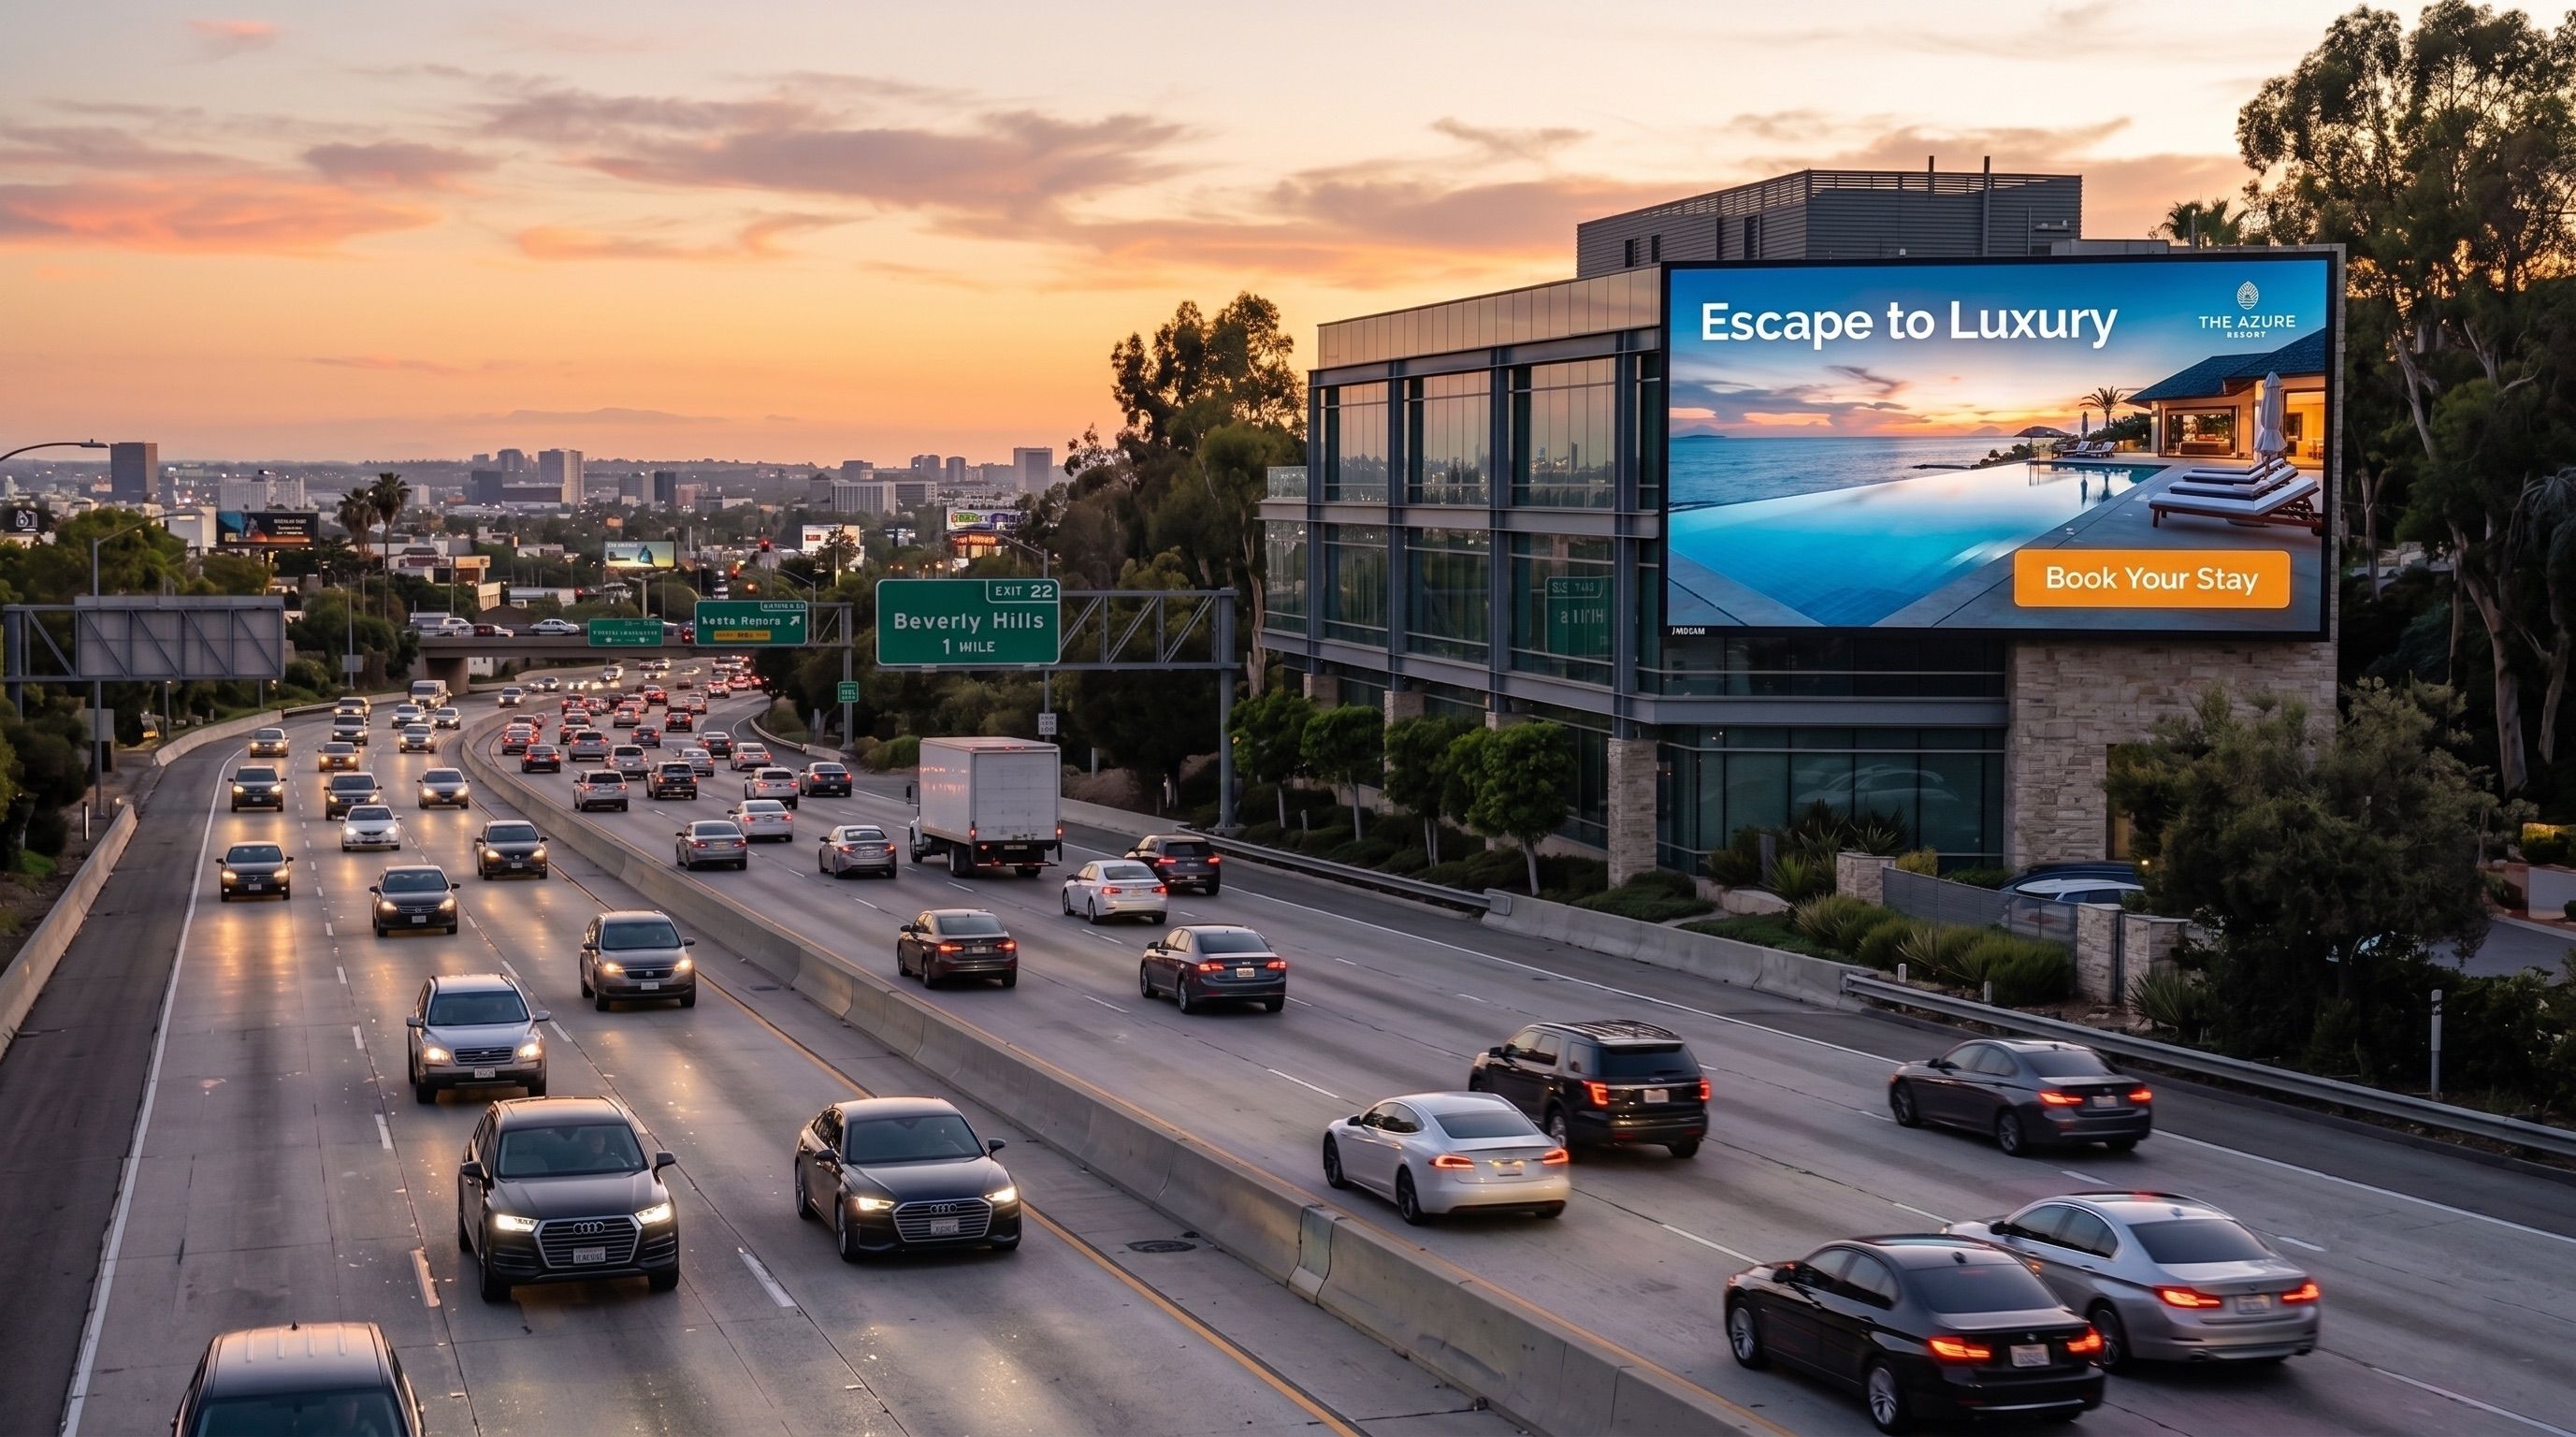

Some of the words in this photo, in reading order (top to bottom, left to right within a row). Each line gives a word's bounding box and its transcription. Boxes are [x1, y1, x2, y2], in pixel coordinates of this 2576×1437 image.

[1701, 302, 1874, 351] Escape
[1887, 301, 1935, 341] to
[1950, 300, 2119, 350] Luxury
[2199, 315, 2233, 329] THE
[2237, 314, 2296, 328] AZURE
[2226, 330, 2266, 339] RESORT
[2046, 565, 2118, 589] Book
[2125, 567, 2191, 590] Your
[2196, 567, 2259, 597] Stay
[995, 586, 1022, 596] EXIT
[1030, 584, 1053, 599] 22
[893, 612, 981, 634] Beverly
[992, 611, 1045, 630] Hills
[943, 638, 950, 655] 1
